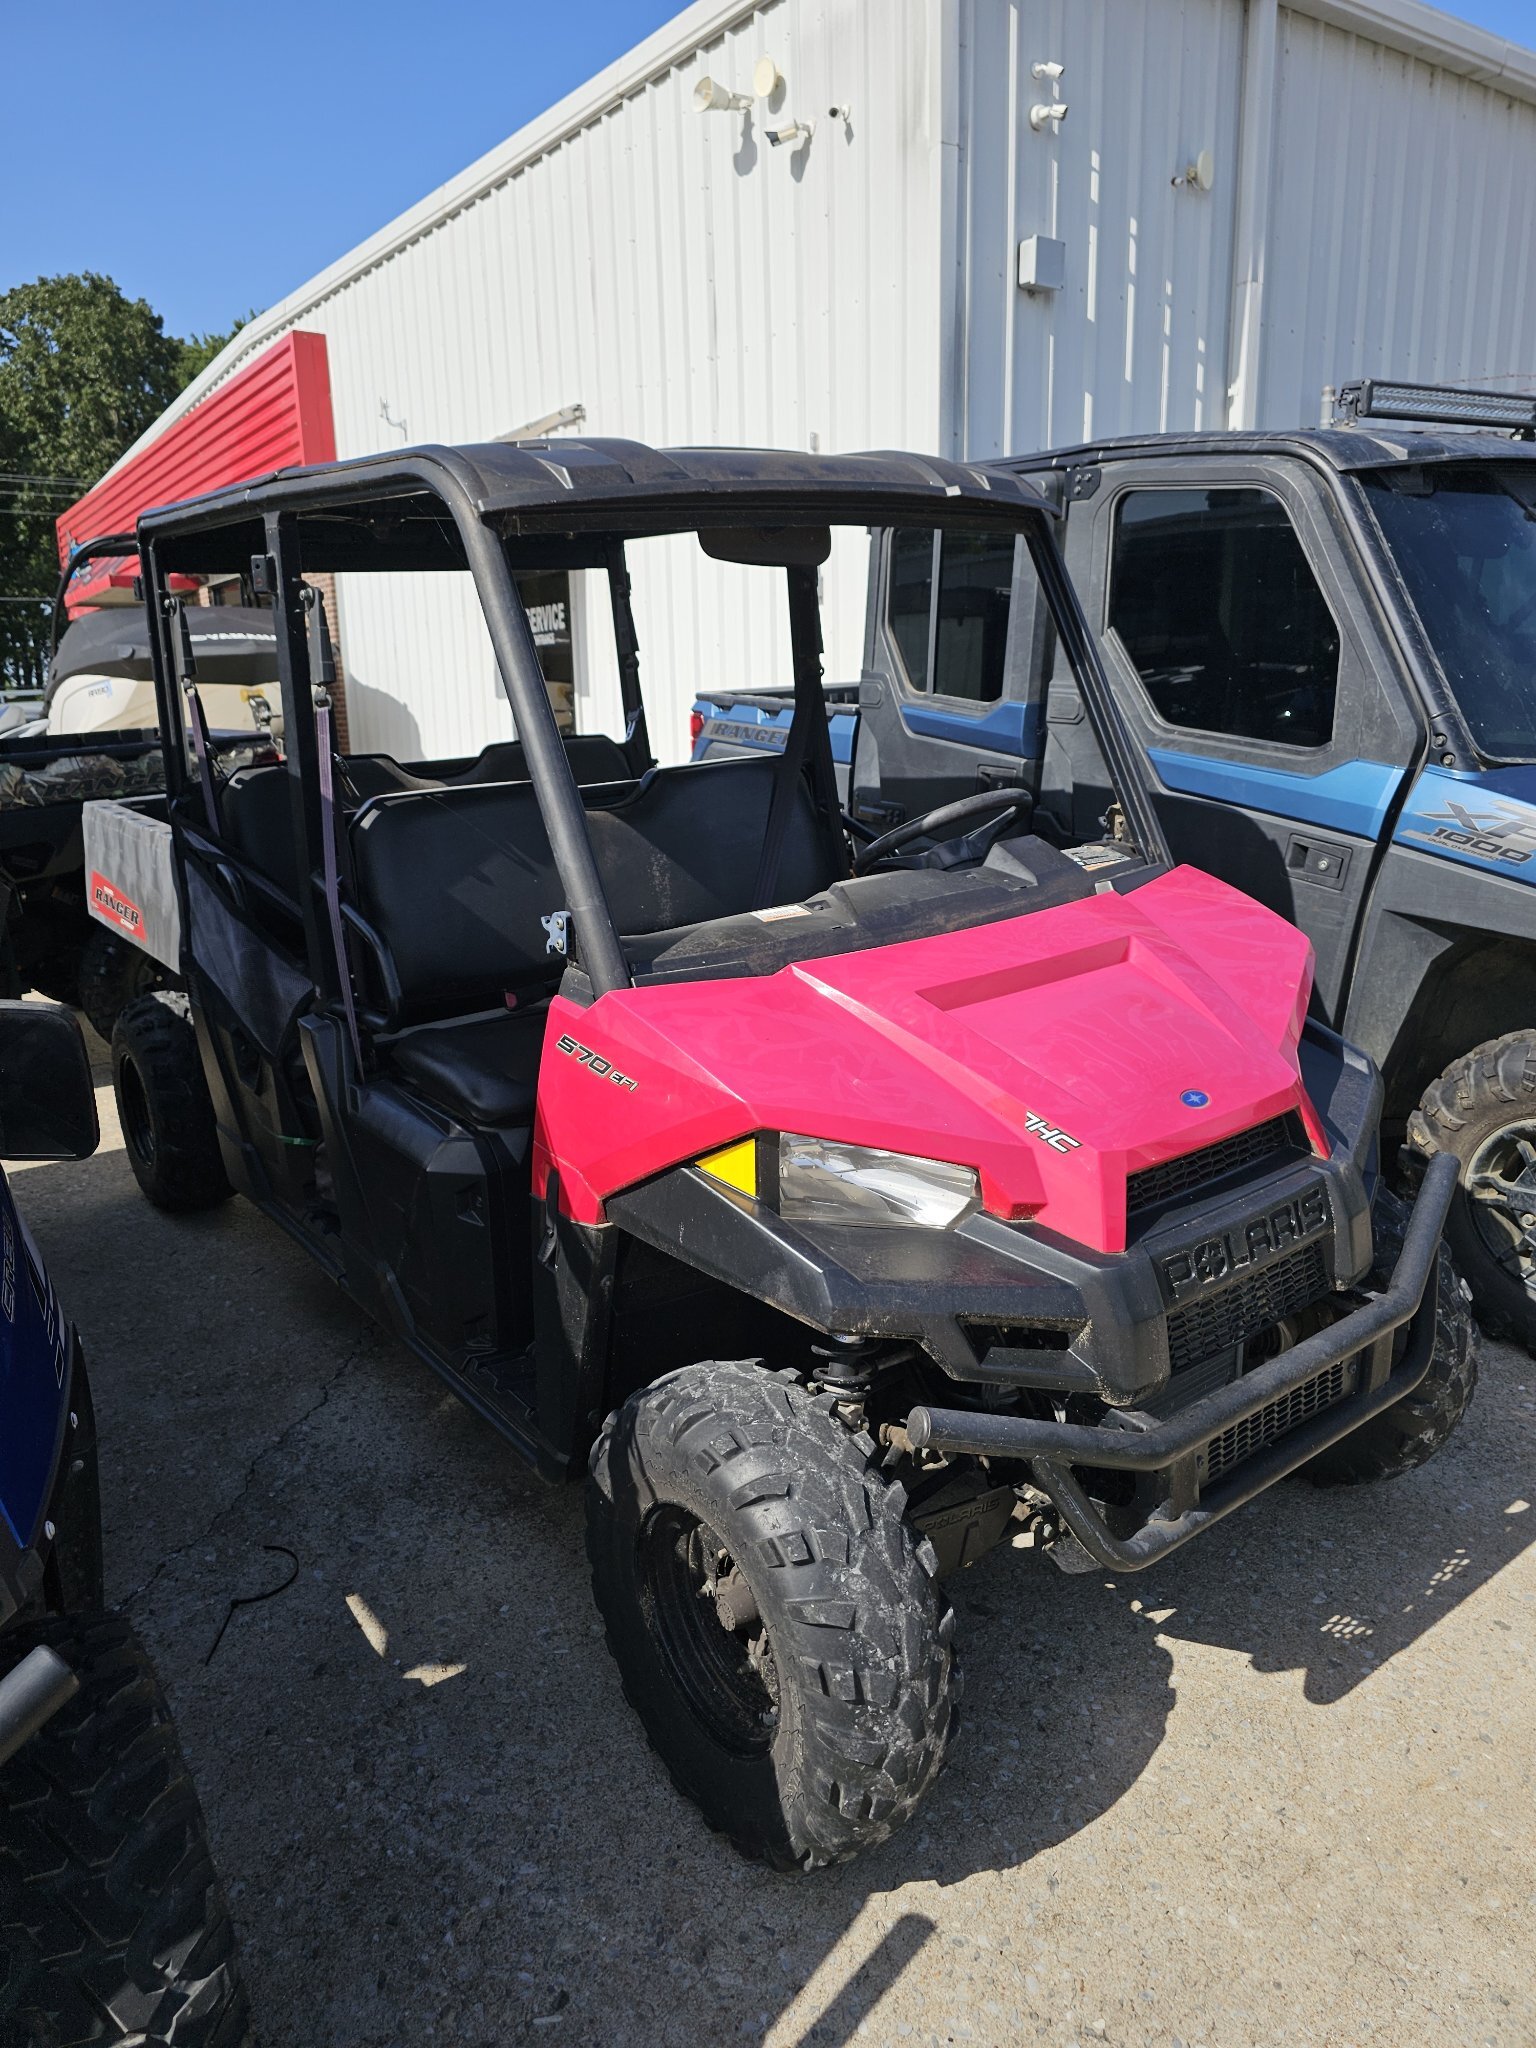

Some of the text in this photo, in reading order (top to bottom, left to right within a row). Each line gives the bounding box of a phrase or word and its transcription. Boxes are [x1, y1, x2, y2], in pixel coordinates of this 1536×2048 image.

[95, 886, 140, 926] RANGER
[556, 1033, 638, 1092] 570 EFI
[1160, 1186, 1327, 1299] POLARIS
[924, 1498, 1000, 1531] POLARIS
